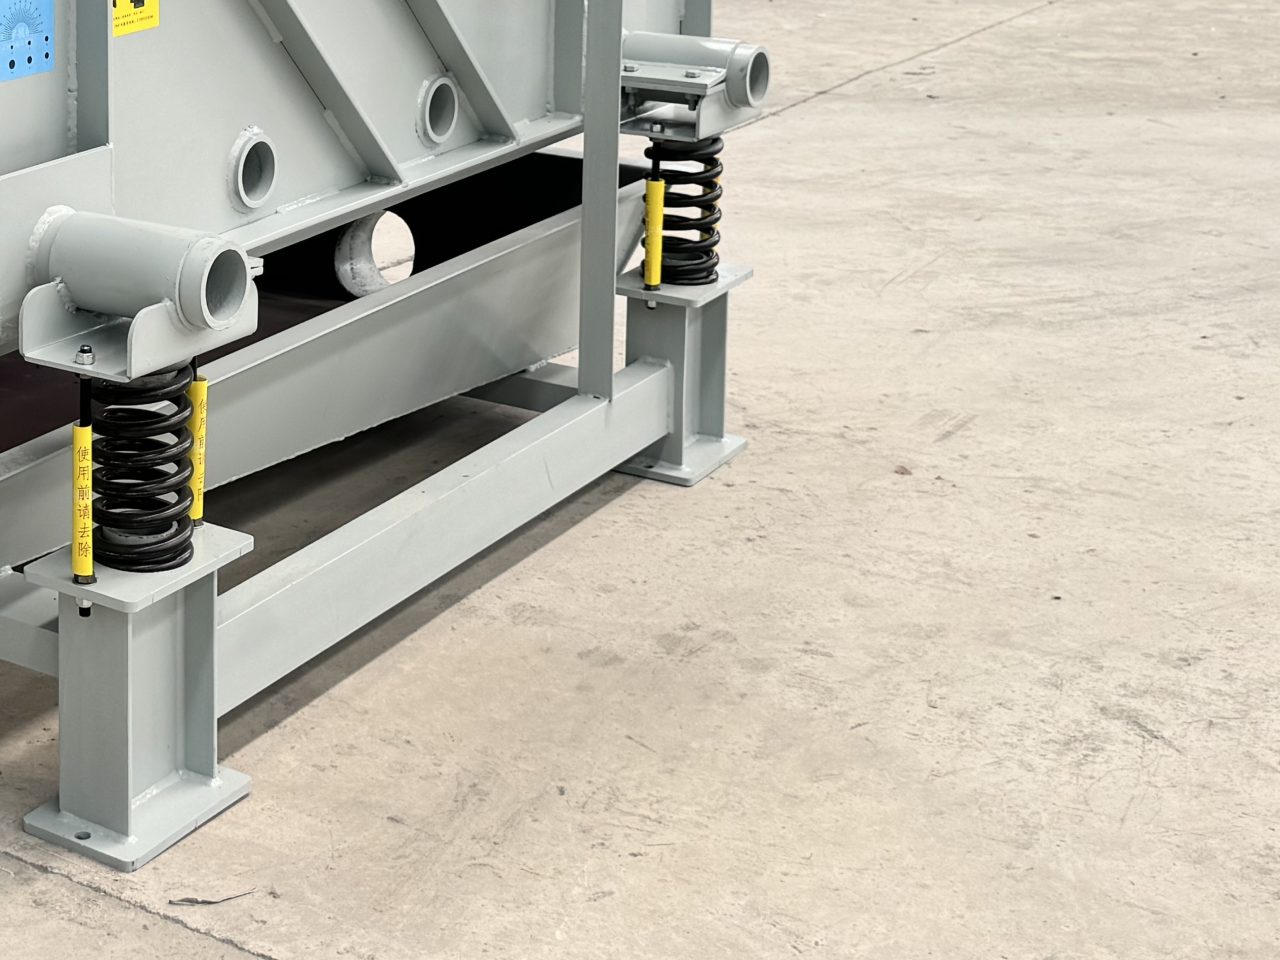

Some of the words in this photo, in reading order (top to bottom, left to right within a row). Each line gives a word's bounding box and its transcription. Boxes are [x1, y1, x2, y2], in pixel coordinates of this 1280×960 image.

[76, 446, 91, 557] 使用前请去除
